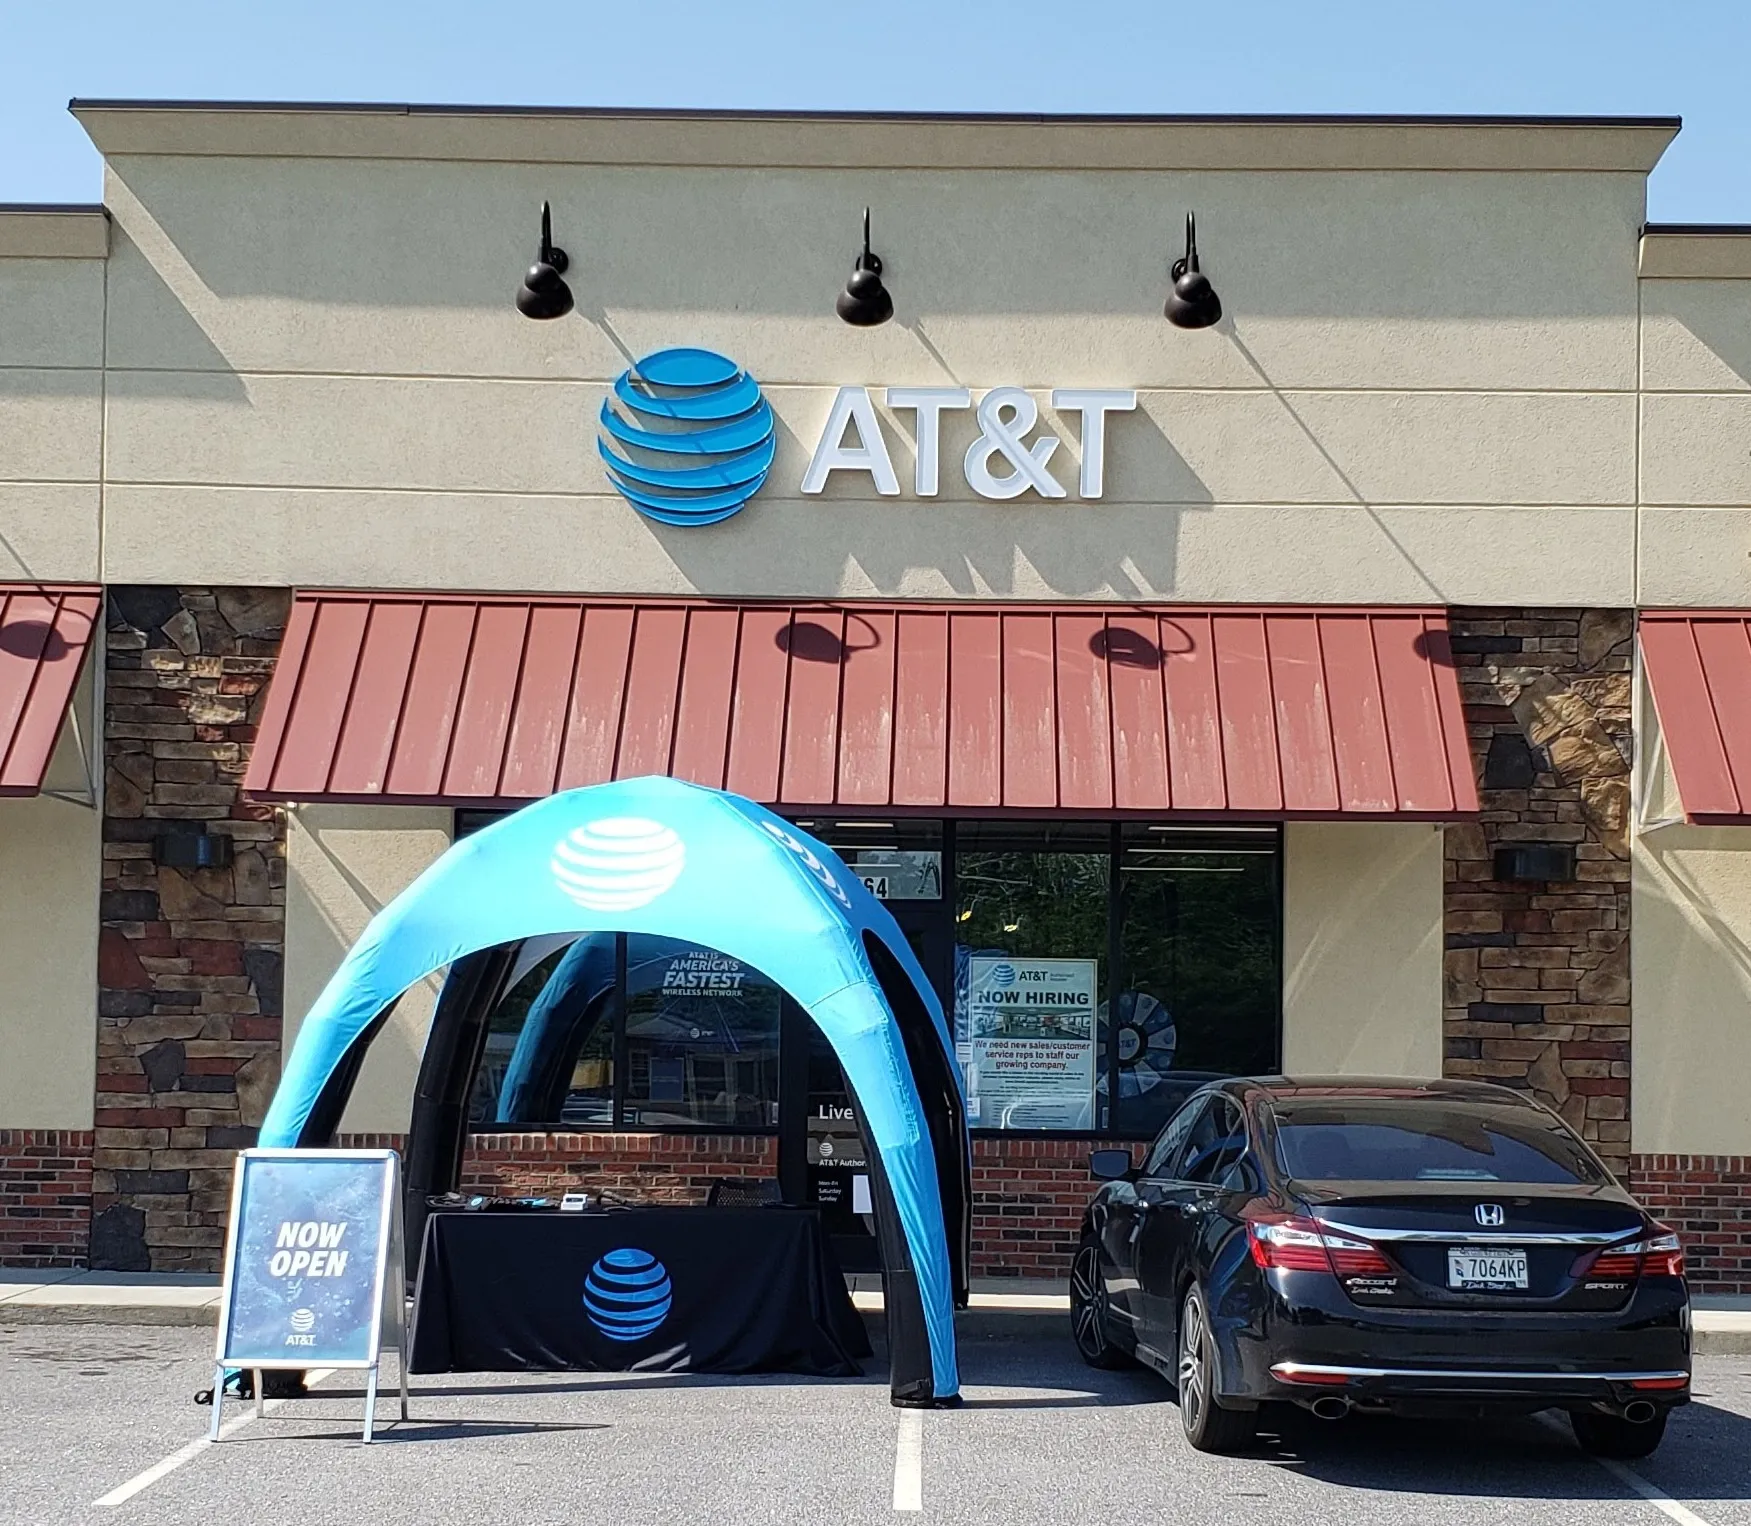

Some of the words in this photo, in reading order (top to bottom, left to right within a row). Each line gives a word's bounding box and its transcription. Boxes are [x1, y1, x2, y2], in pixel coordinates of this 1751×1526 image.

[800, 386, 1137, 498] AT&T
[670, 959, 740, 971] AMERICA'S
[662, 971, 746, 988] FASTEST
[1018, 971, 1048, 982] AT&T
[662, 988, 701, 996] WIRELESS
[702, 989, 744, 997] NETWORK
[977, 991, 1020, 1003] NOW
[1026, 992, 1089, 1005] HIRING
[975, 1040, 987, 1048] We
[989, 1041, 1008, 1049] need
[1029, 1041, 1090, 1050] sales/customer
[985, 1051, 1014, 1059] service
[1016, 1052, 1034, 1060] reps
[1036, 1051, 1044, 1059] to
[1046, 1051, 1063, 1059] staff
[995, 1060, 1028, 1070] growing
[1030, 1061, 1068, 1070] company.
[818, 1104, 854, 1120] Live
[276, 1221, 348, 1248] NOW
[270, 1250, 349, 1277] OPEN
[1468, 1258, 1526, 1278] 7064KP
[1584, 1282, 1629, 1290] SPORT
[285, 1334, 317, 1347] AT&T
